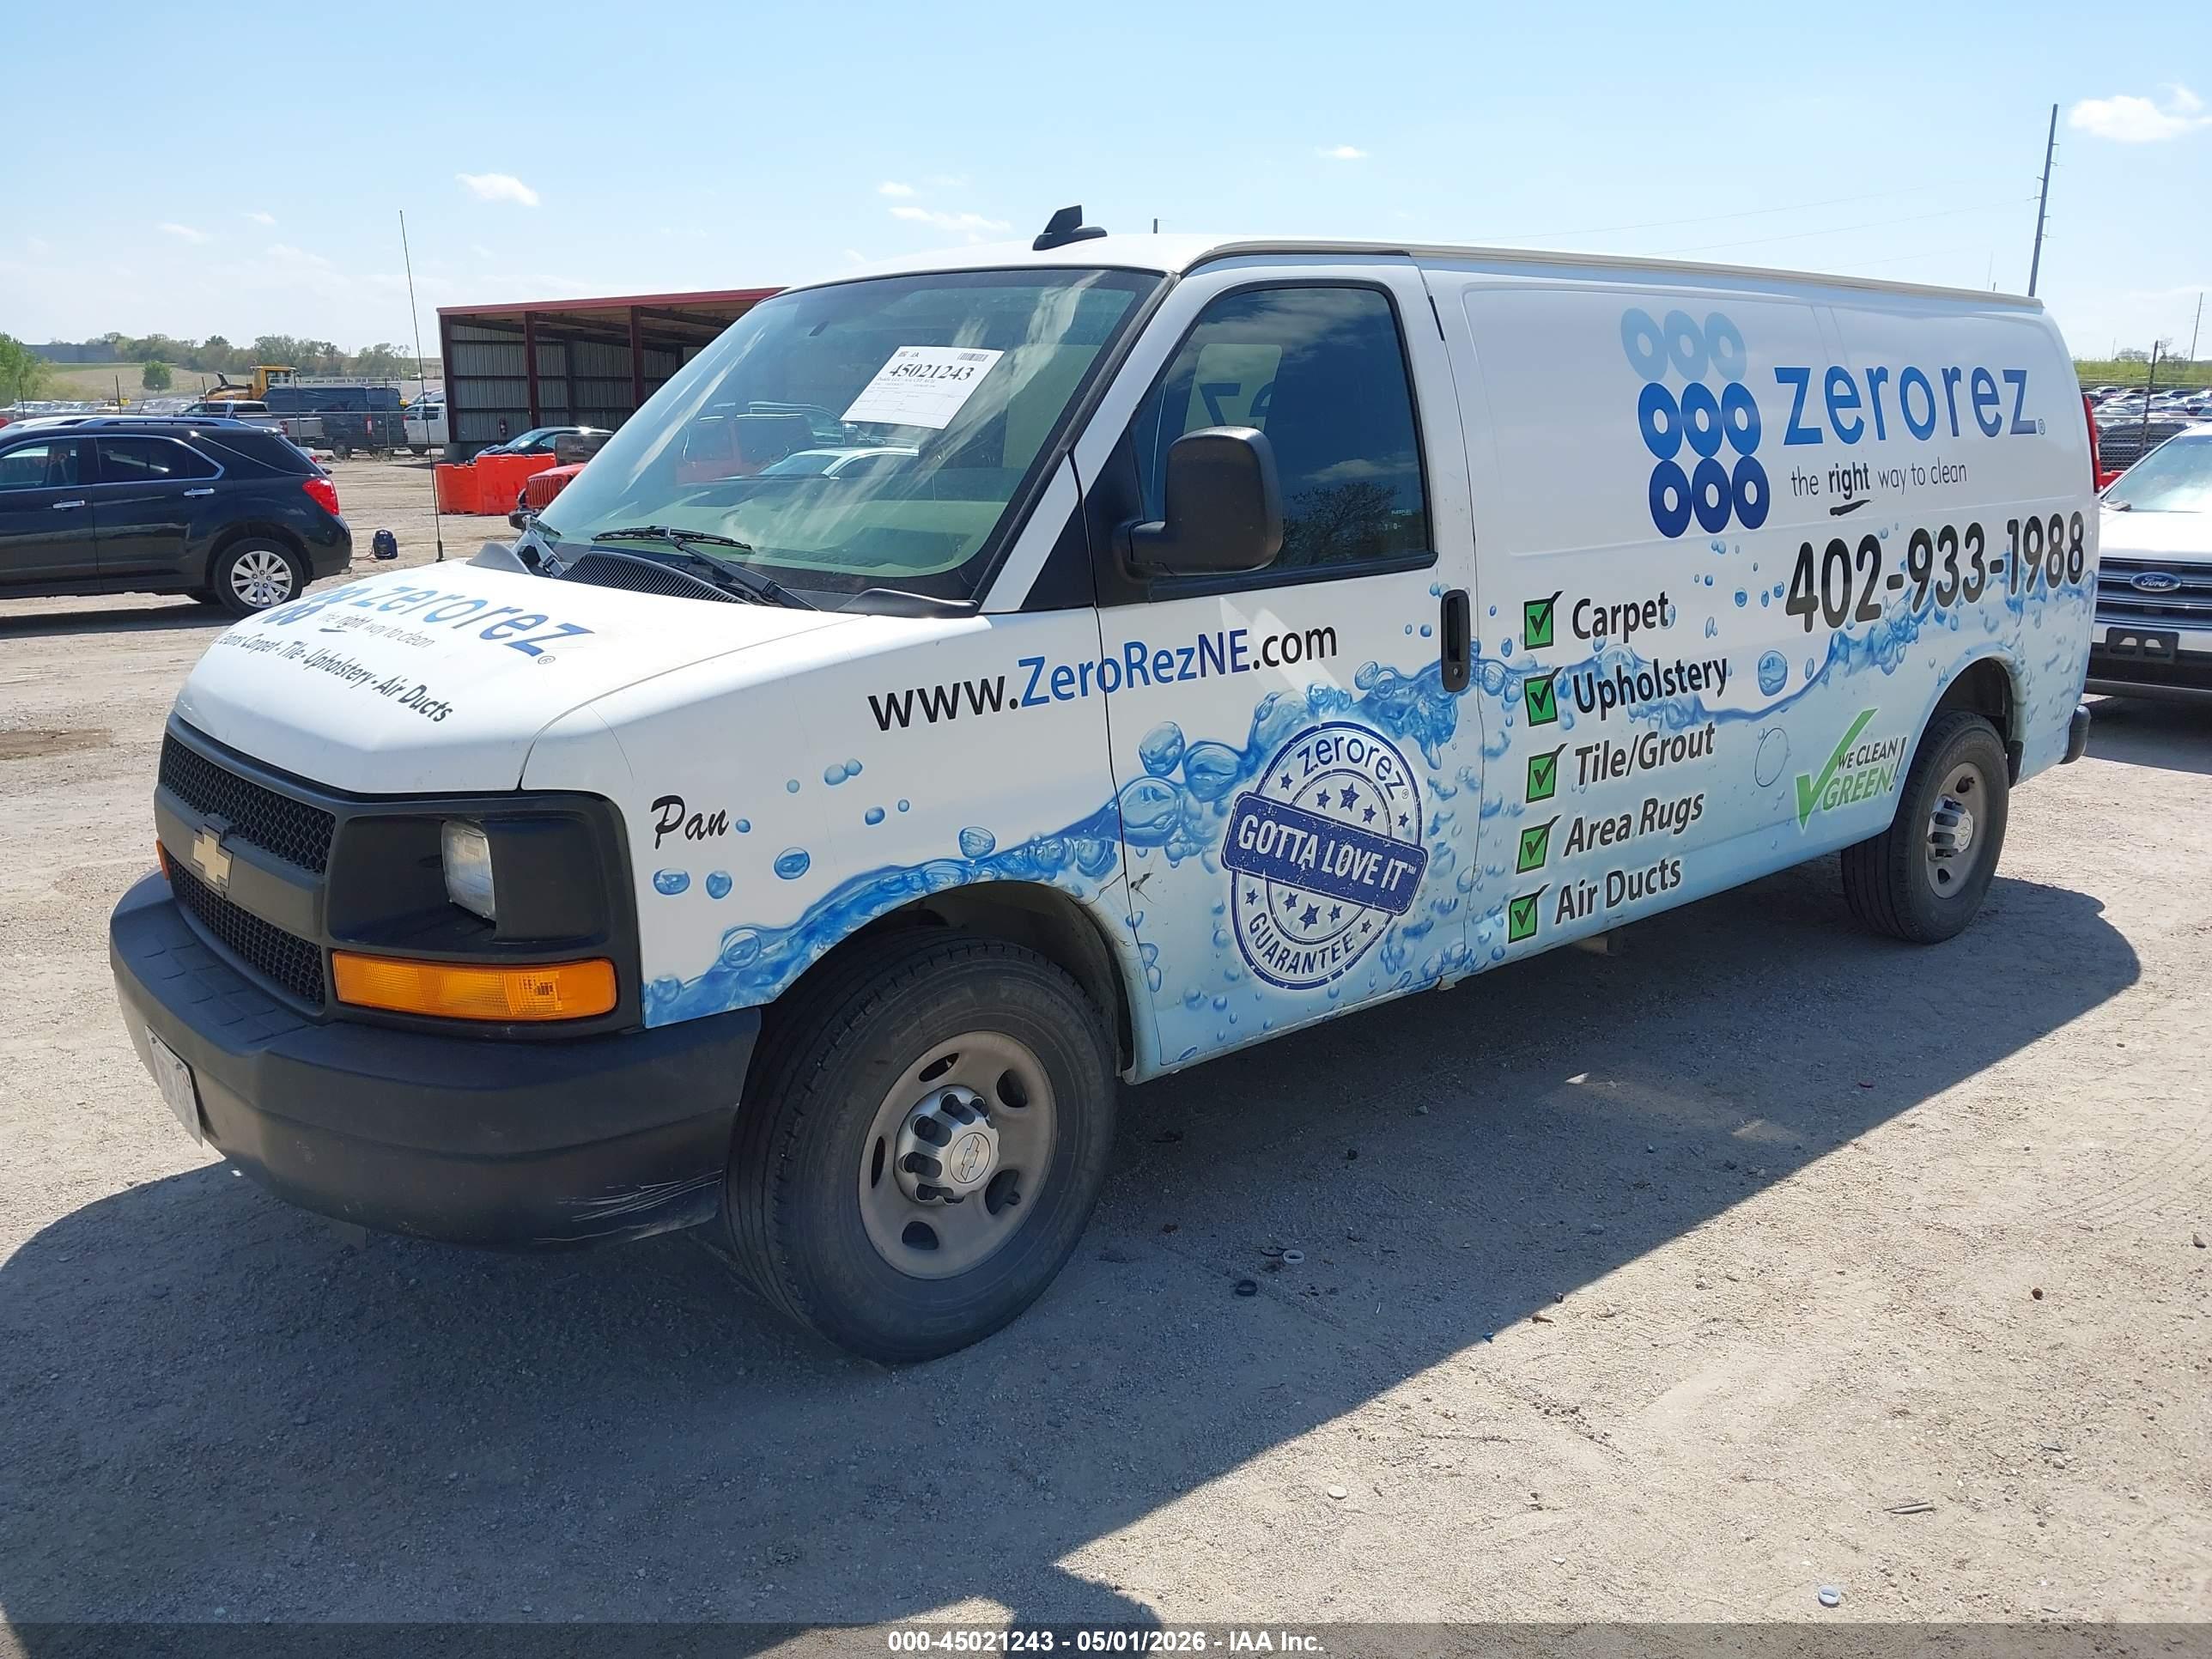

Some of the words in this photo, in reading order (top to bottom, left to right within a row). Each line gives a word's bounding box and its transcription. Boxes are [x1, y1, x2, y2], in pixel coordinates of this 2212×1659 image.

[889, 363, 975, 380] 45021243
[1791, 466, 1819, 496] the
[1828, 462, 1870, 500] right
[1878, 469, 1906, 495] way
[1911, 463, 1925, 486] to
[1931, 457, 1967, 484] clean
[1785, 511, 2084, 634] 402-933-1988
[2141, 575, 2169, 587] Ford
[364, 623, 392, 637] way
[383, 627, 404, 638] to
[397, 630, 435, 648] clean
[1572, 591, 1668, 642] Carpet
[240, 633, 283, 654] Carpet
[277, 641, 308, 660] Tile
[303, 648, 377, 689] Upholstery
[373, 675, 408, 697] Air
[398, 684, 453, 722] Ducts
[867, 625, 1338, 732] www.ZeroRezNE.com
[1573, 658, 1728, 721] Upholstery
[1575, 722, 1716, 787] Tile/Grout
[1823, 737, 1907, 811] GREEN!
[1838, 751, 1855, 772] WE
[1856, 738, 1899, 767] CLEAN
[651, 795, 729, 849] Pan
[1237, 815, 1319, 869] GOTTA
[1322, 840, 1382, 886] LOVE
[1564, 814, 1632, 857] Area
[1638, 793, 1705, 836] Rugs
[1555, 878, 1598, 925] Air
[1606, 859, 1681, 908] Ducts
[1249, 912, 1354, 975] GUARANTEE
